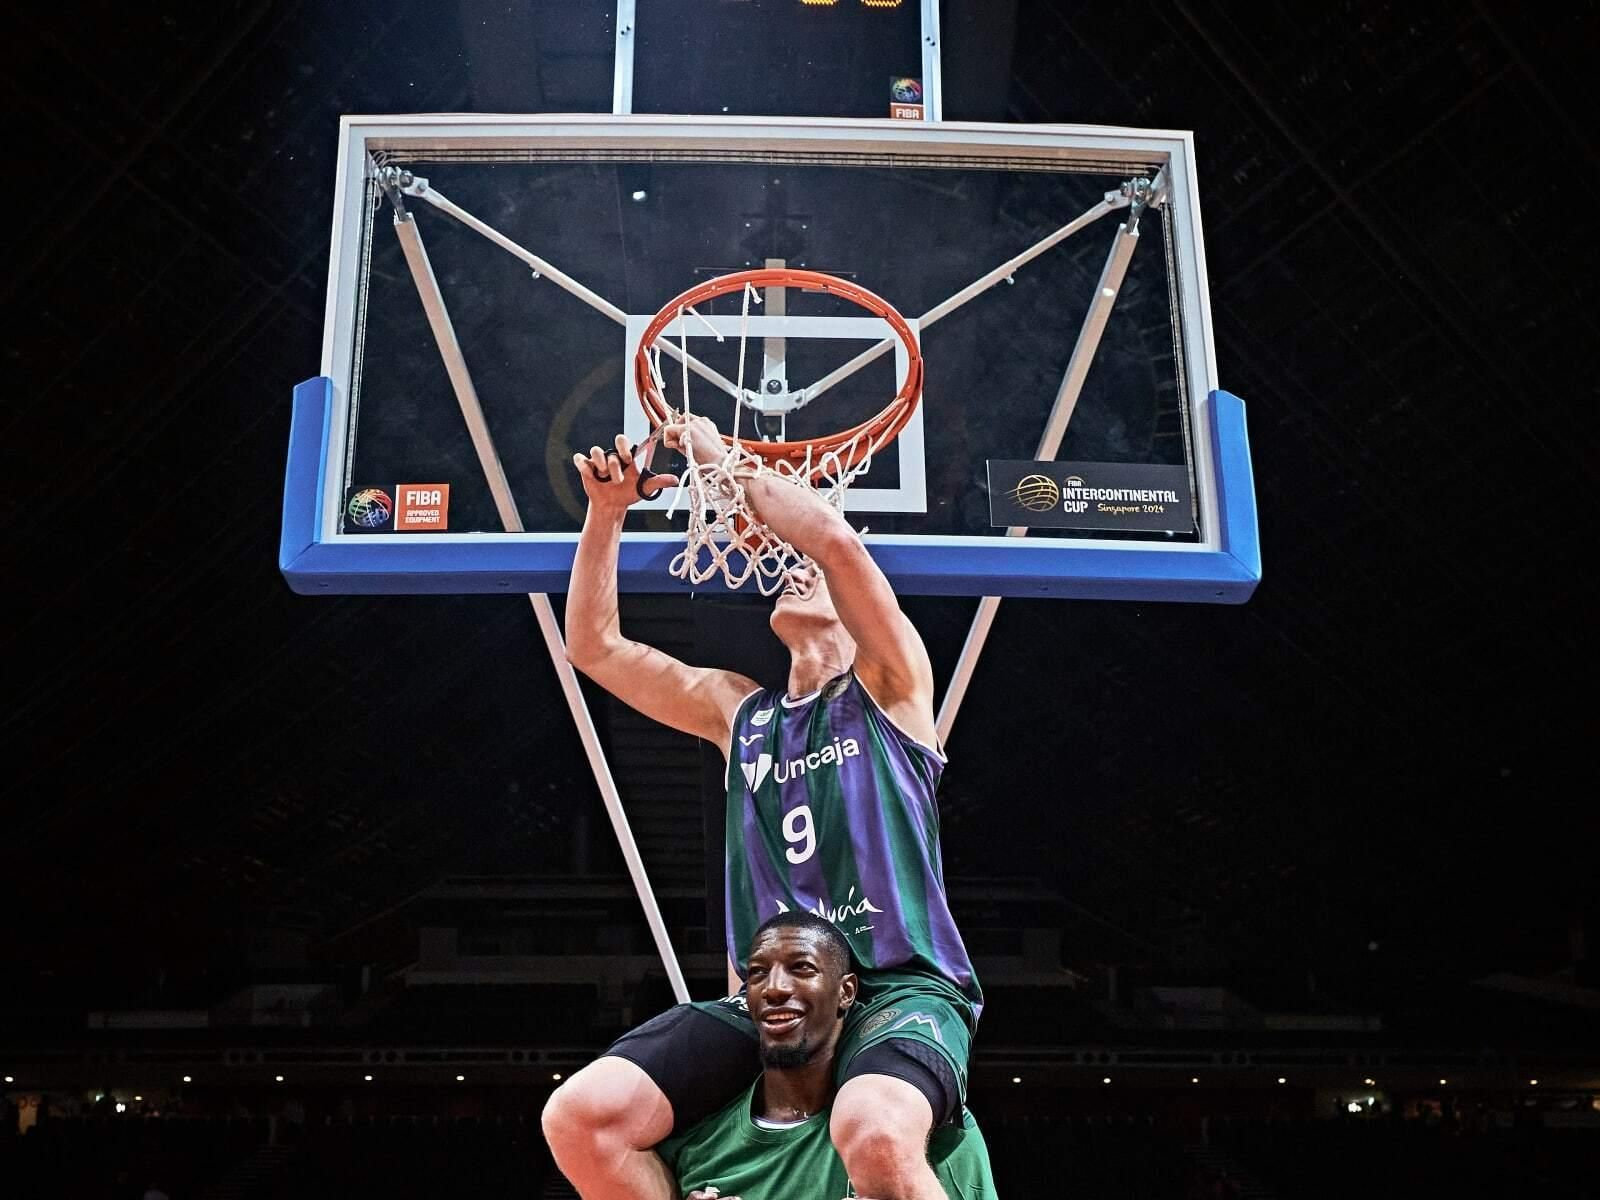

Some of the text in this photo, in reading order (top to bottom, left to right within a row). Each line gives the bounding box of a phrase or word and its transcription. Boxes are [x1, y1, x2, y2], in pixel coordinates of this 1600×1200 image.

[895, 109, 920, 119] FIBA
[406, 490, 442, 506] FIBA
[1062, 488, 1180, 503] INTERCONTINENTAL
[1064, 501, 1165, 516] CUP Singapore 2024
[773, 737, 860, 784] Uncaja
[782, 805, 817, 865] 9
